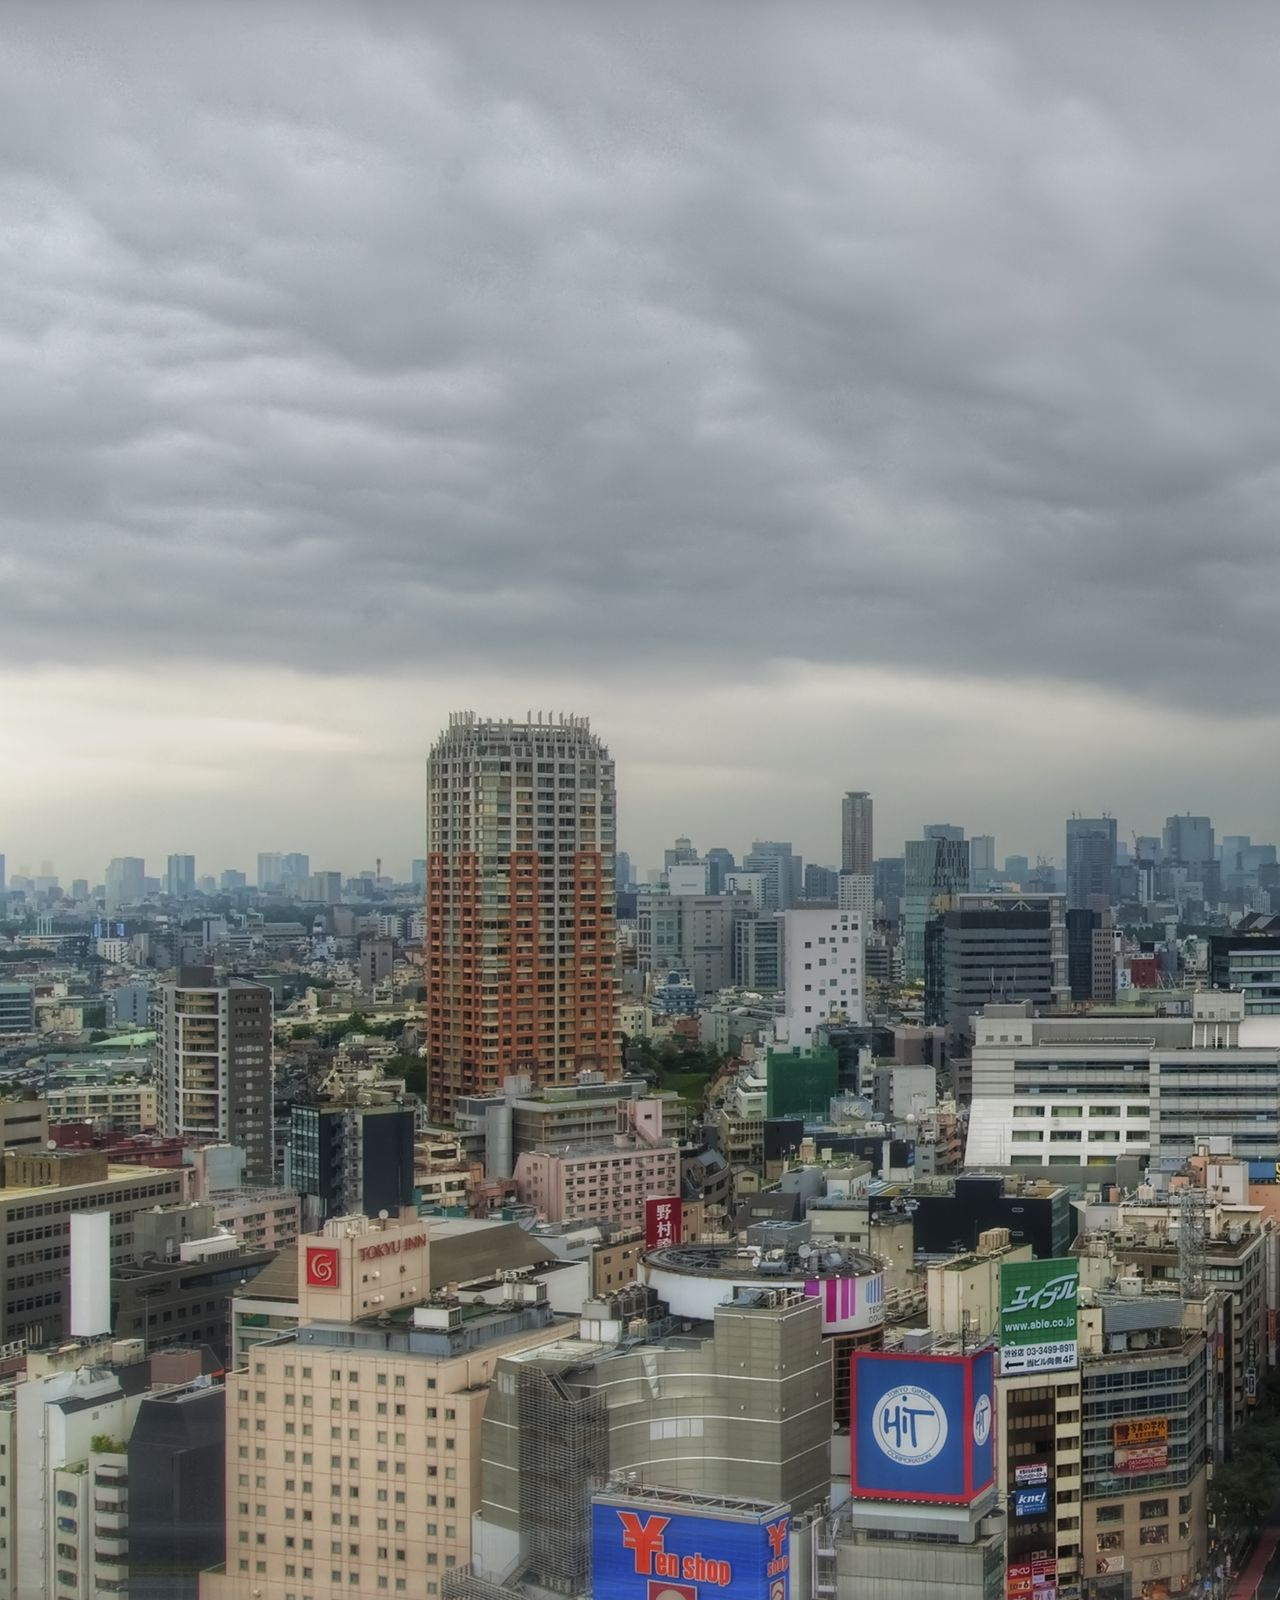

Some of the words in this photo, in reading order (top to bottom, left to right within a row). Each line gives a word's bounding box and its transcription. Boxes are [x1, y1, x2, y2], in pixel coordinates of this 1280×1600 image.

[359, 1240, 401, 1262] TOKYU
[404, 1233, 427, 1251] INN
[1002, 1273, 1078, 1313] エイブル
[1005, 1317, 1075, 1332] www.able.co.jp
[886, 1387, 909, 1399] TOKYO
[911, 1387, 932, 1400] GINZA
[682, 1552, 732, 1586] shop
